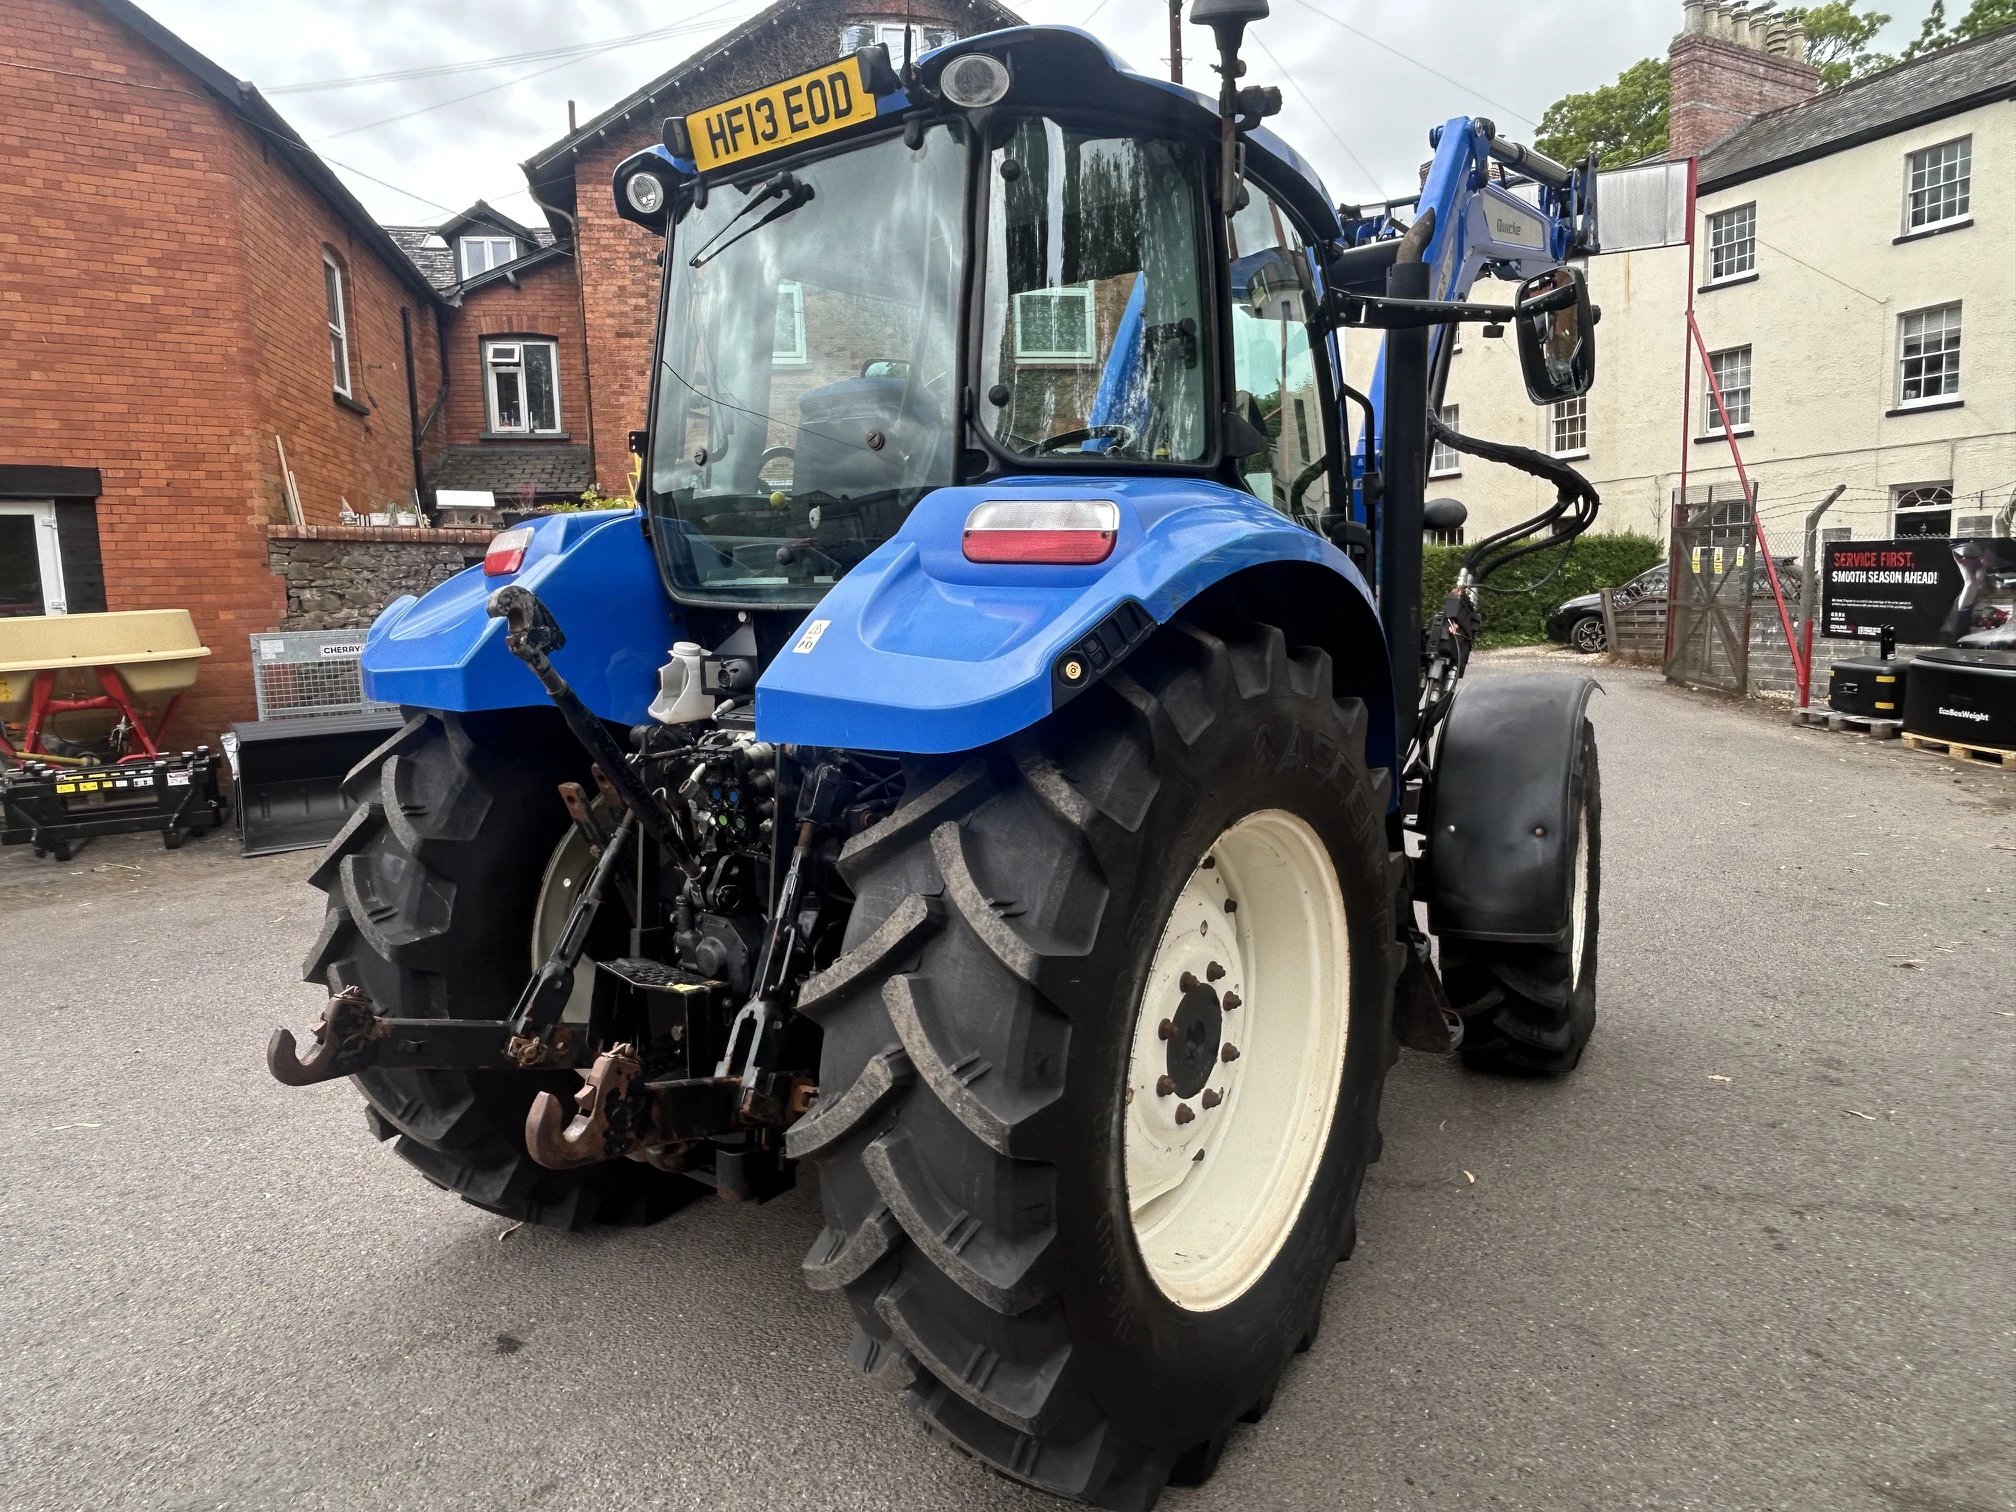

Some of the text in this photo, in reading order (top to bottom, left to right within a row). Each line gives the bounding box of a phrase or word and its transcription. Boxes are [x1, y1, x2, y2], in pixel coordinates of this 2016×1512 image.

[706, 71, 853, 159] HF13 EOD
[1496, 218, 1522, 236] Quicke
[1833, 552, 1915, 569] SERVICE FIRST,
[1832, 570, 1938, 585] SMOOTH SEASON AHEAD!
[1938, 706, 1990, 722] EcoBoxWeight
